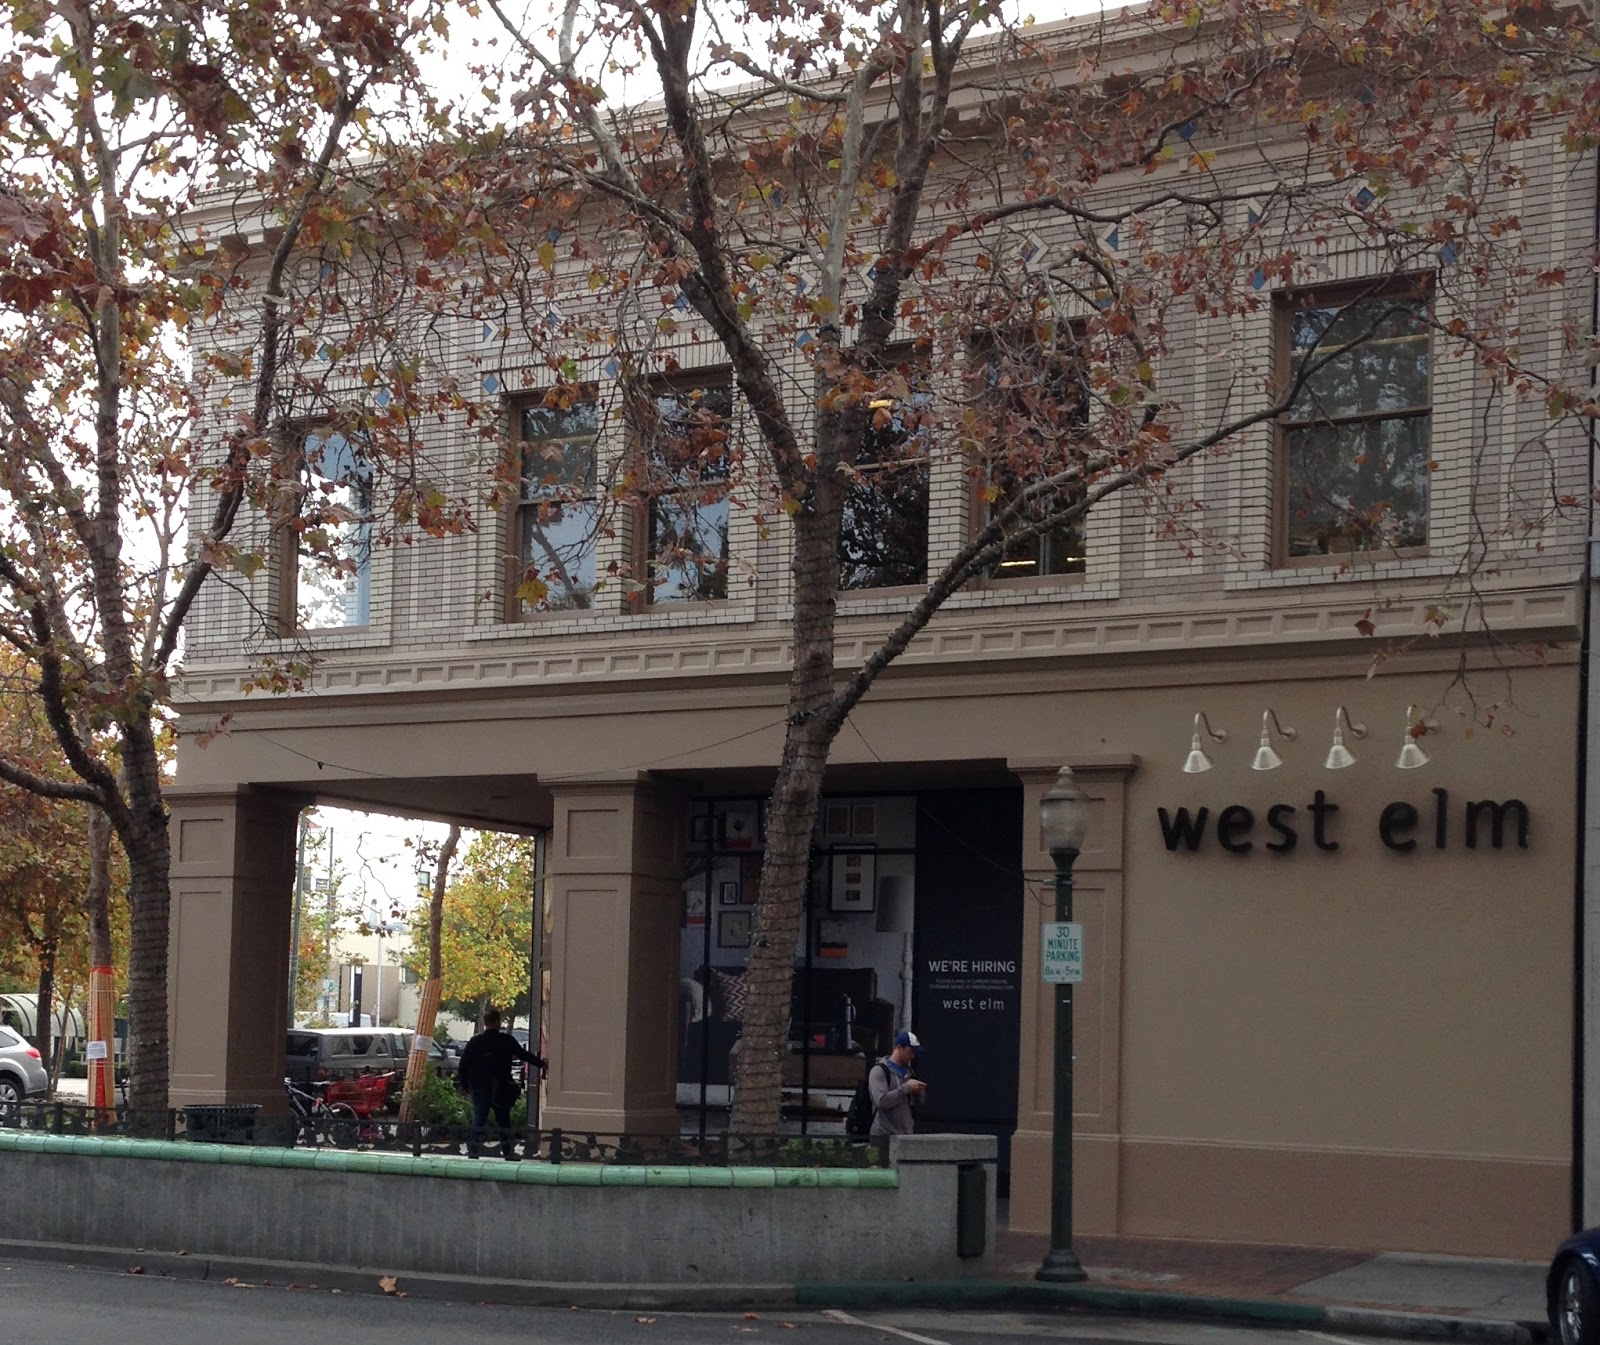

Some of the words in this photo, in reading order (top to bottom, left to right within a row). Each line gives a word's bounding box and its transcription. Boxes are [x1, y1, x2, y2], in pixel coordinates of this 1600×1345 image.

[1157, 789, 1340, 853] west
[1379, 787, 1530, 852] elm
[1056, 926, 1070, 938] 30
[1047, 939, 1079, 950] MINUTE
[1046, 951, 1080, 962] PARKING
[928, 960, 968, 972] WE'RE
[971, 961, 1016, 973] HIRING
[942, 998, 974, 1010] west
[979, 998, 1004, 1010] elm
